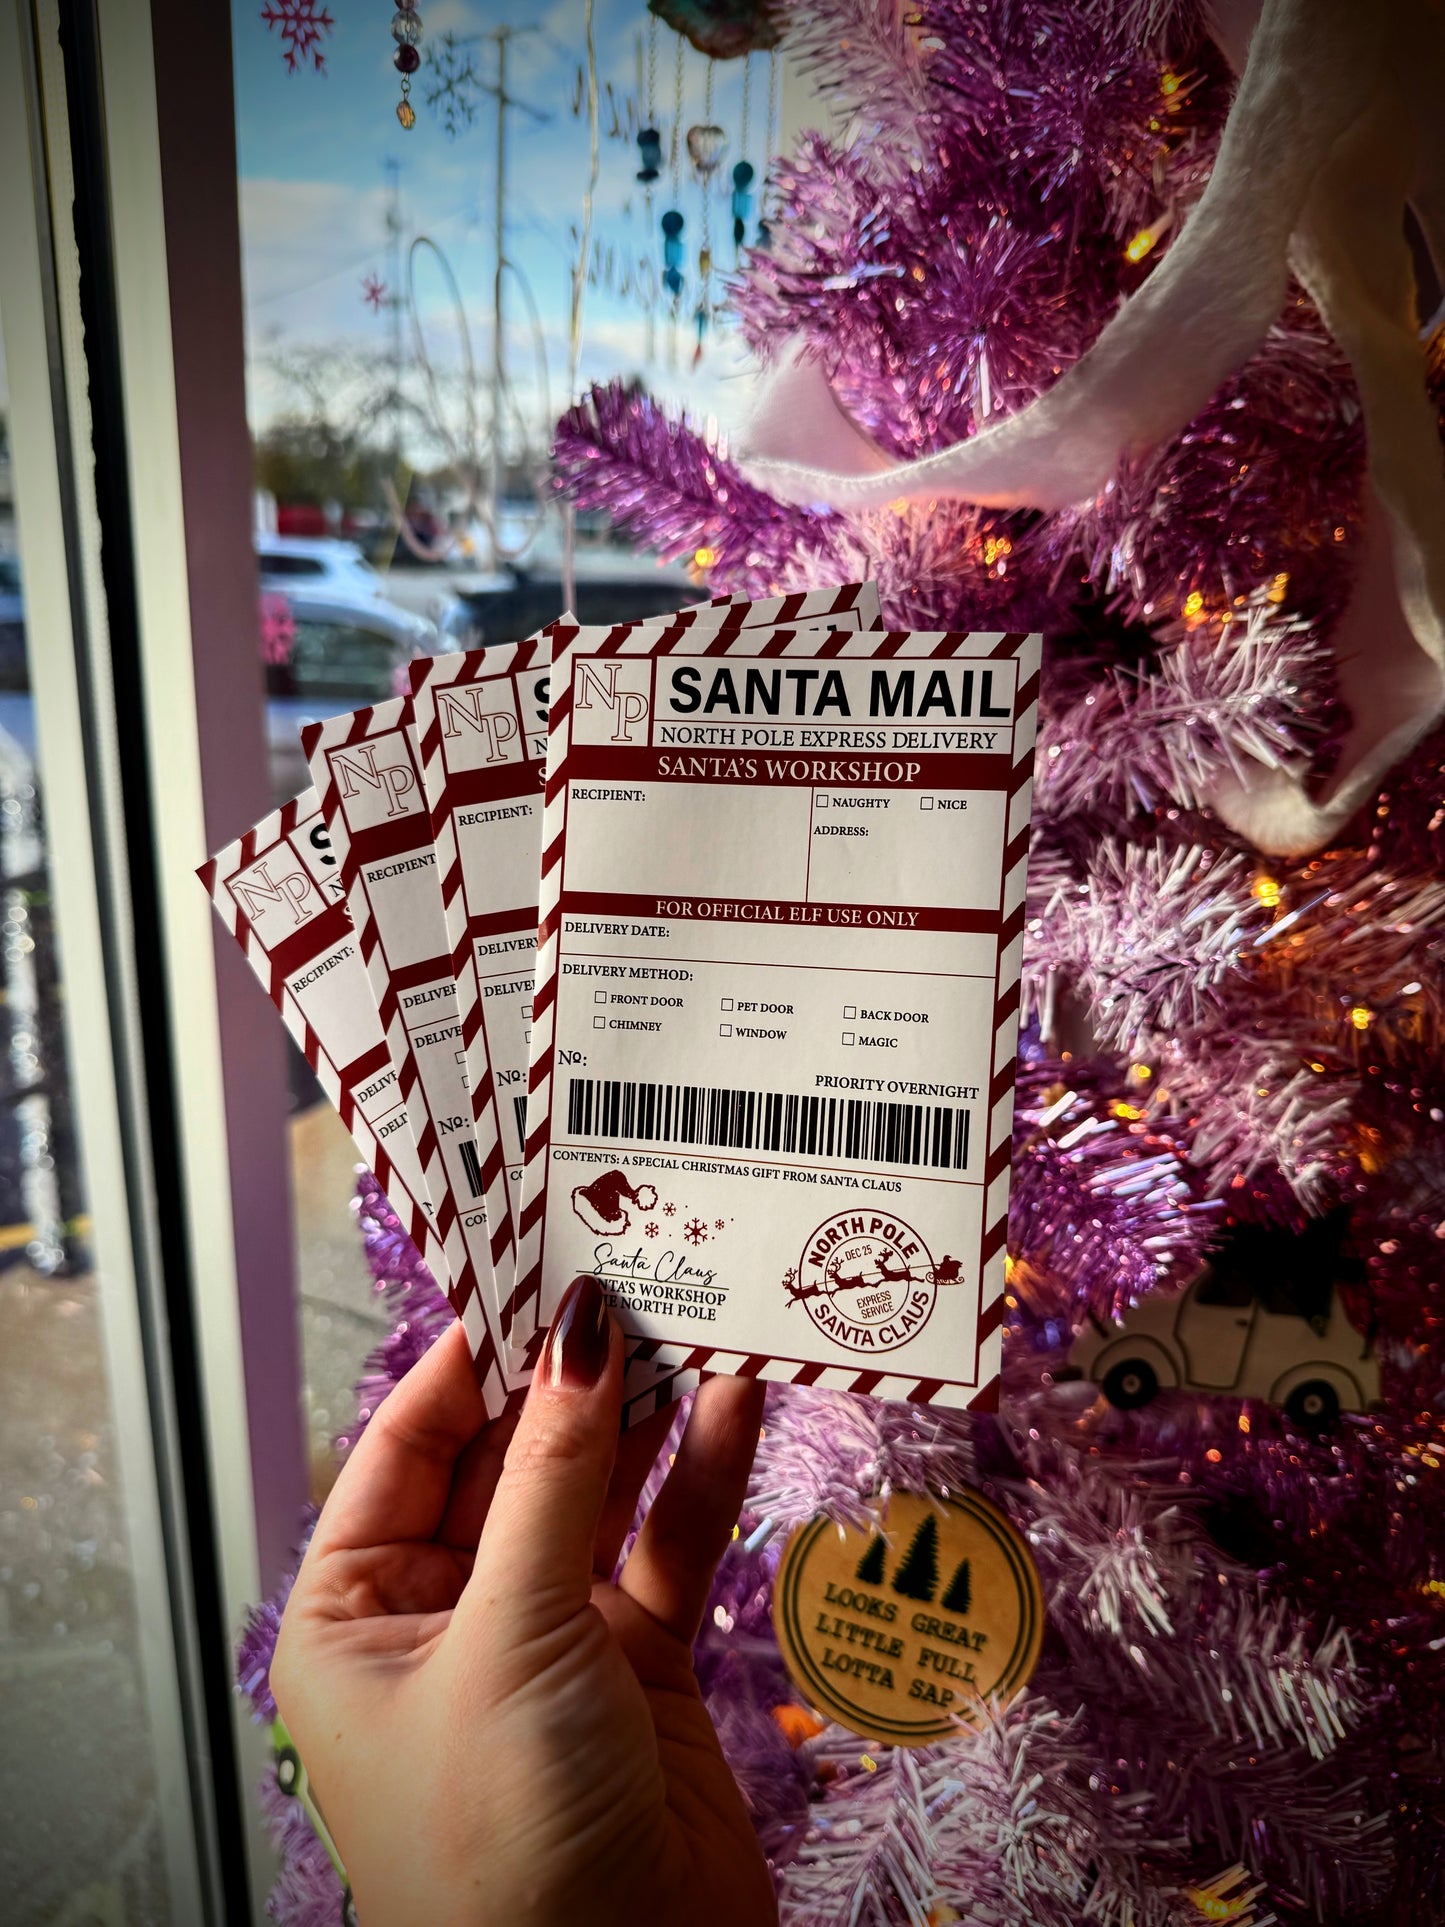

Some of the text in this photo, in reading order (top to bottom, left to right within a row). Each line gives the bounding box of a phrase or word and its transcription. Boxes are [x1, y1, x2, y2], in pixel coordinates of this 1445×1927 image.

[669, 666, 1011, 719] SANTA MAIL
[660, 727, 998, 751] NORTH POLE EXPRESS DELIVERY
[657, 756, 921, 783] SANTA'S WORKSHOP
[571, 788, 646, 802] RECIPIENT:
[832, 797, 890, 810] NAUGHTY
[937, 799, 968, 810] NICE
[458, 804, 534, 827] RECIPIENT:
[813, 825, 869, 837] ADDRESS:
[656, 901, 920, 928] FOR OFFICIAL ELF USE ONLY
[564, 921, 670, 938] DELIVERY DATE:
[292, 945, 355, 994] RECIPIENT:
[562, 963, 694, 982] DELIVERY METHOD:
[403, 983, 457, 1009] DELIVER
[484, 979, 535, 998] DELIVE
[610, 993, 684, 1008] FRONT DOOR
[737, 1001, 794, 1014] PET DOOR
[609, 1019, 662, 1032] CHIMNEY
[860, 1009, 929, 1023] BACK DOOR
[414, 1025, 462, 1049] DELIVE
[735, 1026, 787, 1040] WINDOW
[858, 1035, 898, 1048] MAGIC
[815, 1074, 980, 1100] PRIORITY OVERNIGHT
[553, 1149, 902, 1193] CONTENTS: A SPECIAL CHRISTMAS GIFT FROM SANTA CLAUS
[808, 1216, 920, 1268] NORTH POLE
[845, 1244, 873, 1261] DEC 25
[593, 1242, 718, 1285] Santa Claus
[598, 1278, 636, 1294] NTA'S
[639, 1283, 726, 1306] WORKSHOP
[856, 1290, 892, 1309] EXPRESS
[620, 1295, 673, 1315] NORTH
[677, 1304, 717, 1321] POLE
[814, 1290, 929, 1347] SANTA CLAUS
[861, 1301, 894, 1319] SERVICE
[824, 1582, 988, 1652] LOOKS GREAT
[815, 1612, 977, 1684] LITTLE FULL
[821, 1647, 955, 1708] LOTTA SAP
